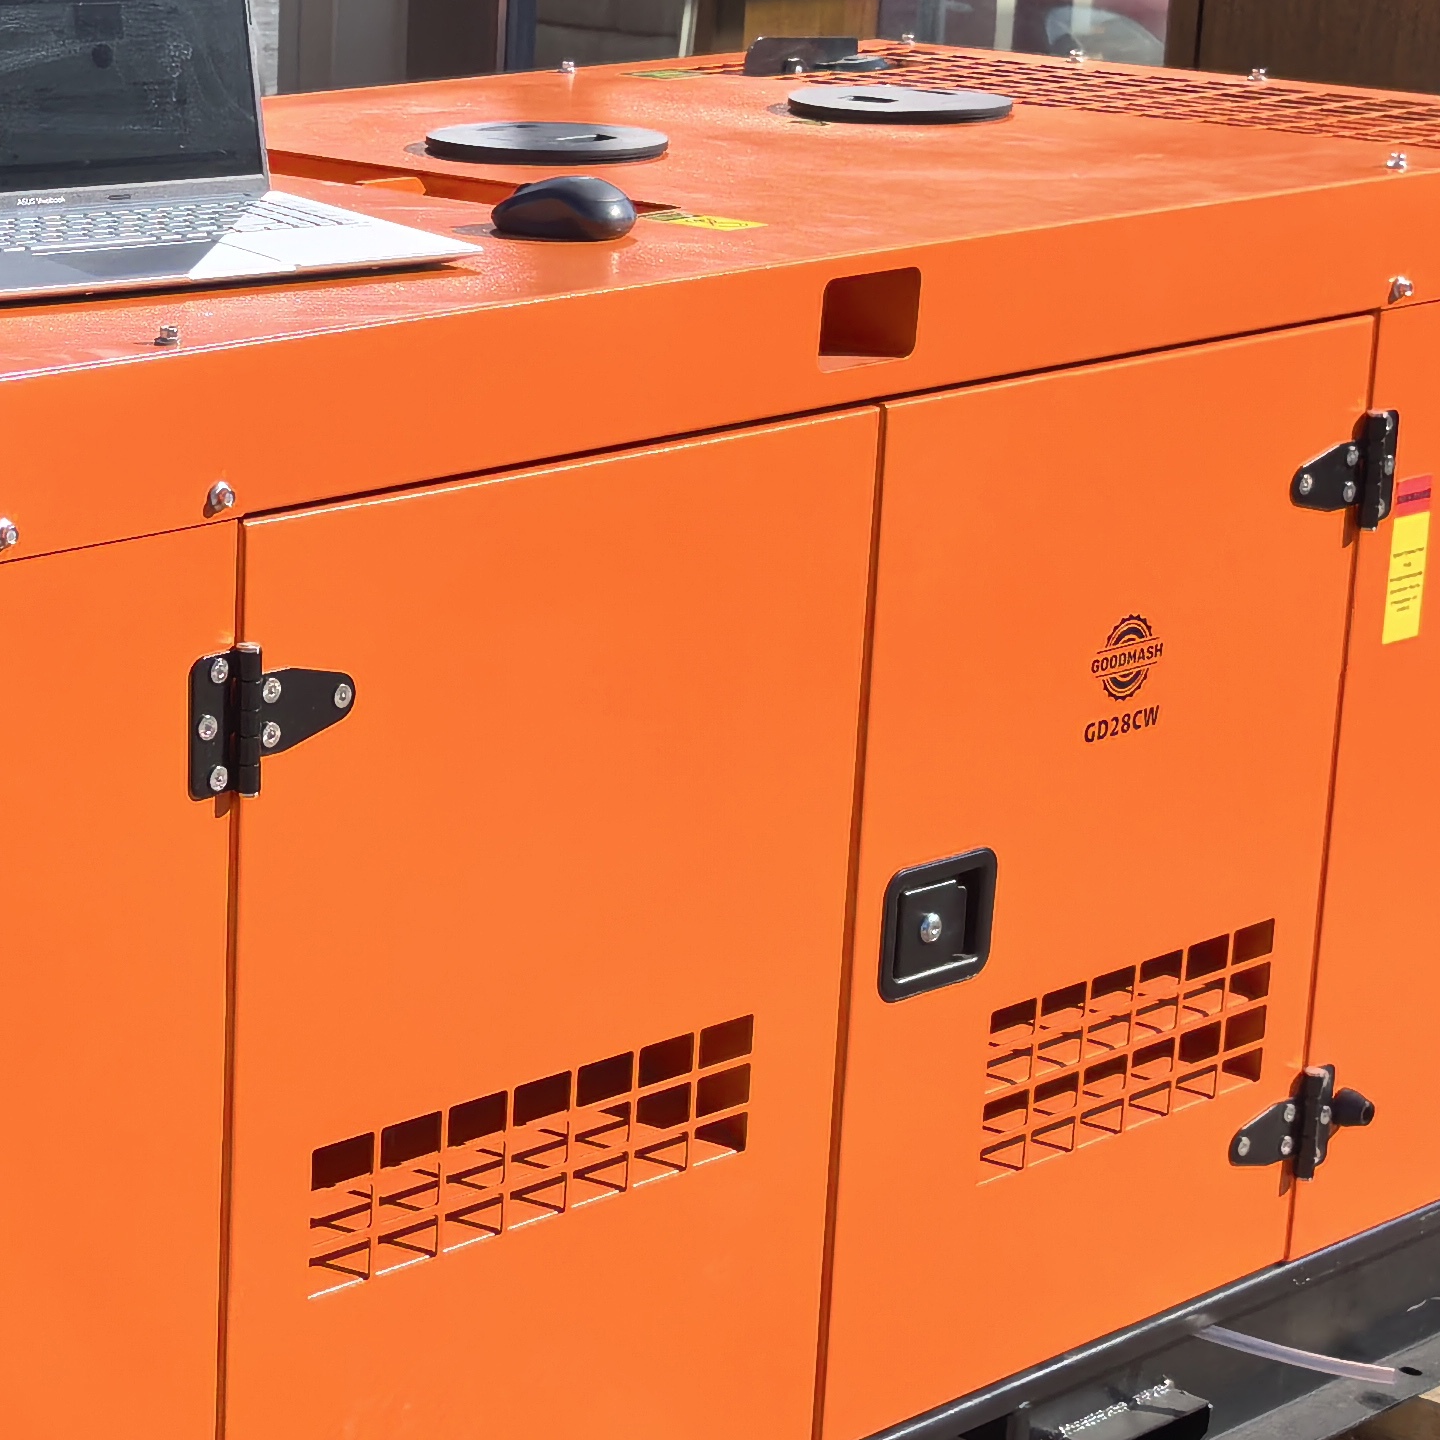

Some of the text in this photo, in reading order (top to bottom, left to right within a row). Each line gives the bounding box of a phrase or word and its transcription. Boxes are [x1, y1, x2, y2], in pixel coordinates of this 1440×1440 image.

[16, 198, 35, 206] ASUS
[1091, 642, 1164, 674] GOODMASH
[1083, 704, 1160, 743] GD28CW
